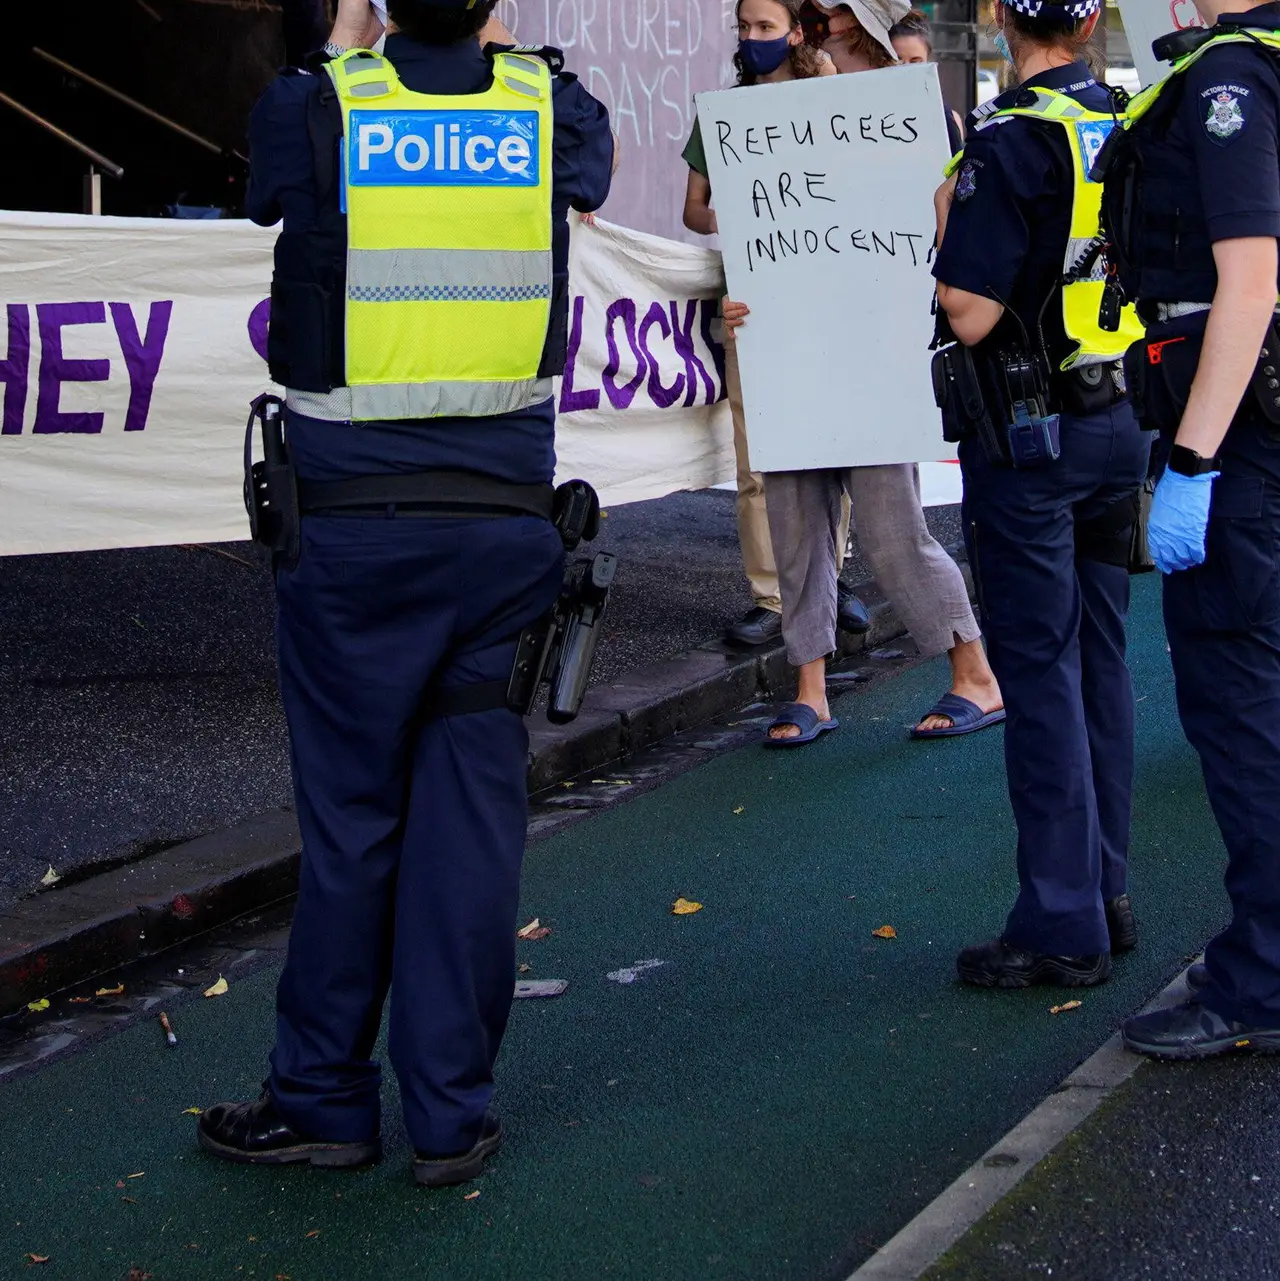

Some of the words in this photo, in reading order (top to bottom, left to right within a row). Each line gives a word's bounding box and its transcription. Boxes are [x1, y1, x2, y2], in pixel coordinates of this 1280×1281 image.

[1200, 85, 1227, 98] VICTORIA
[1227, 84, 1250, 97] POLICE
[357, 122, 531, 173] Police
[715, 112, 919, 166] REFUGEES
[751, 171, 837, 221] ARE
[746, 225, 923, 272] INNOCENT
